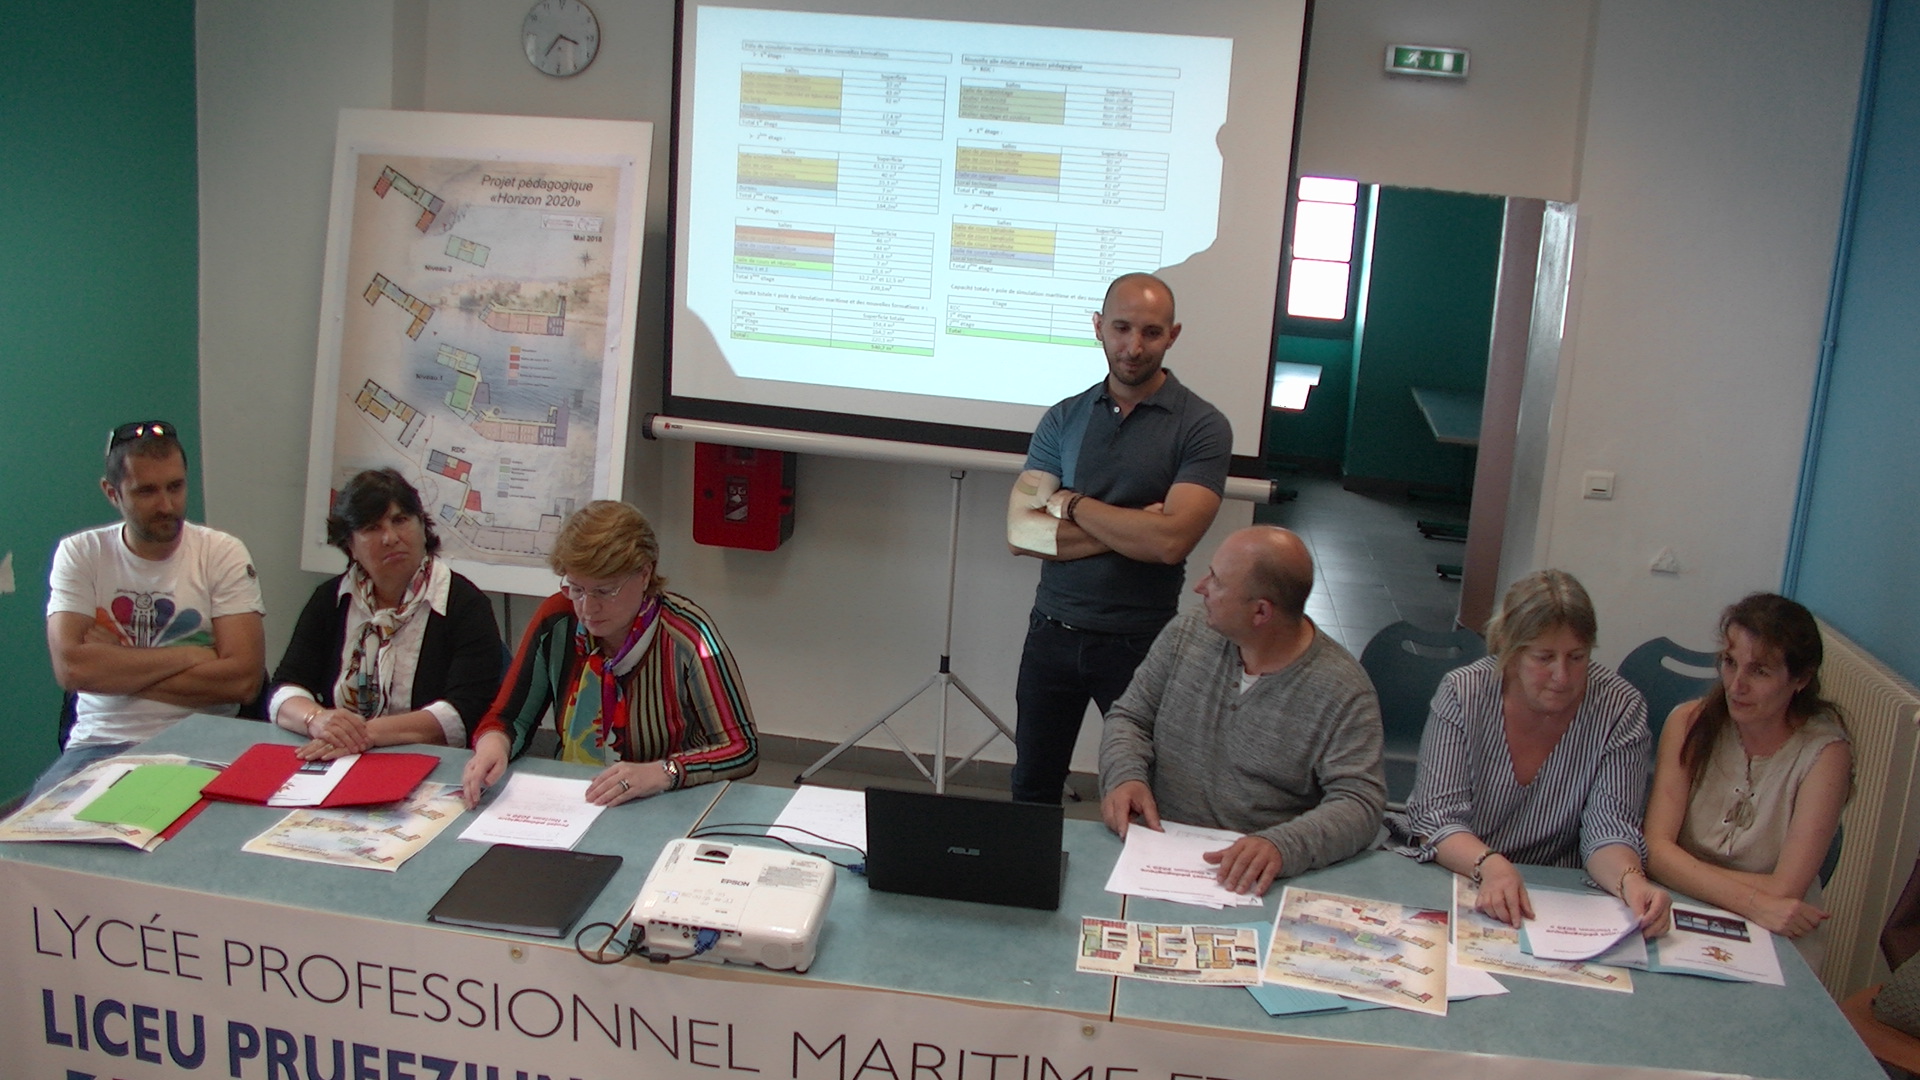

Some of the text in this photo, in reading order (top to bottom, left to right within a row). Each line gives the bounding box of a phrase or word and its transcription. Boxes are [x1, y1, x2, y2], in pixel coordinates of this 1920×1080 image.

[881, 74, 907, 82] Superficie
[481, 174, 594, 193] Projet pédagogique
[490, 193, 581, 207] «Horizon 2020»
[424, 264, 447, 272] Niveau
[891, 302, 920, 310] formations
[416, 373, 438, 381] Niveau
[451, 446, 466, 454] RDC
[947, 846, 980, 856] ASUS
[720, 878, 750, 888] EPSON
[33, 906, 1139, 1080] LYCÉE PROFESSIONNEL MARITI
[42, 988, 206, 1070] LICEU
